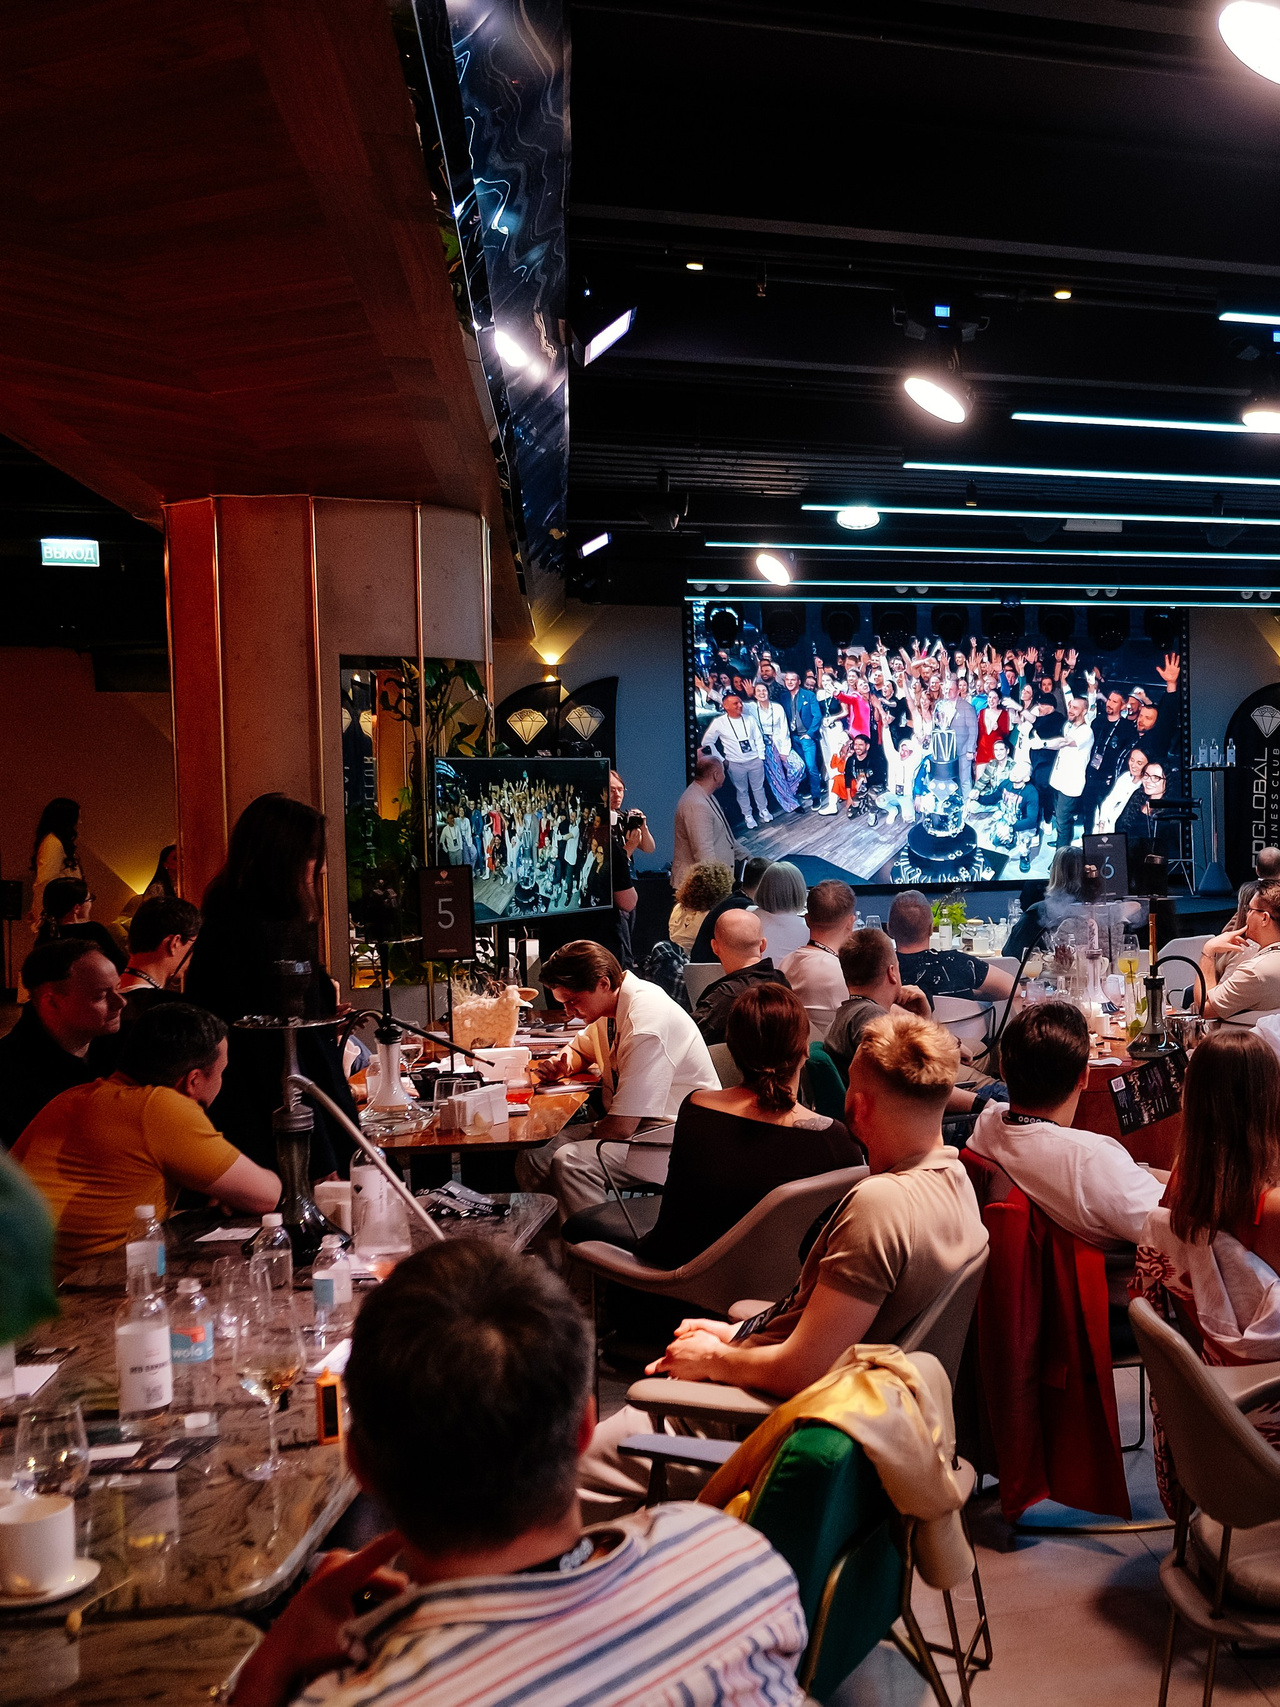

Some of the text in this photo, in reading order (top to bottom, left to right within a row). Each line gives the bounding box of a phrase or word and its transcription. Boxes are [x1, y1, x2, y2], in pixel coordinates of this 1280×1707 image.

[43, 546, 96, 562] ВЫХОД
[1272, 748, 1280, 788] CLUB
[1100, 856, 1114, 879] 6
[437, 898, 455, 929] 5
